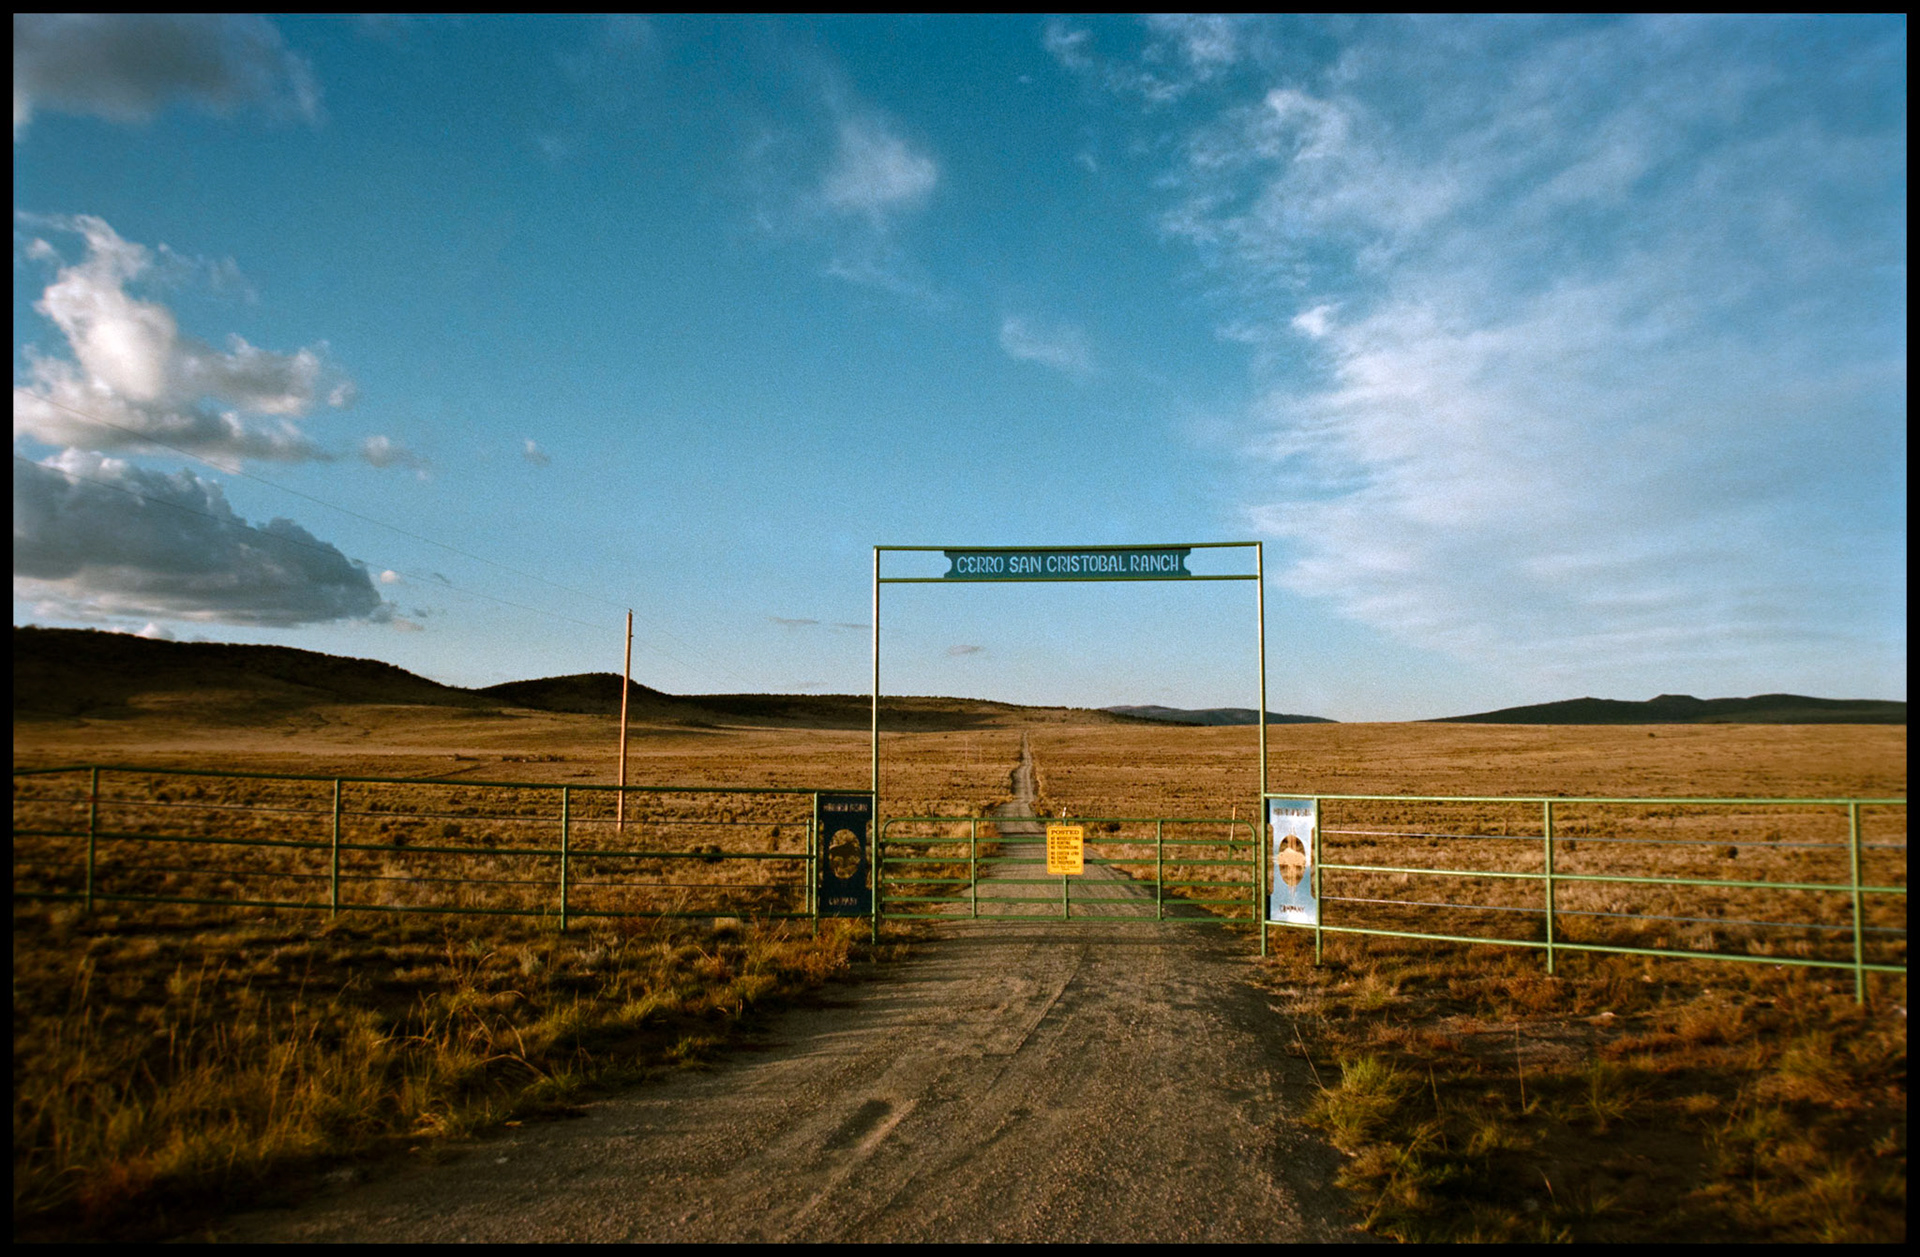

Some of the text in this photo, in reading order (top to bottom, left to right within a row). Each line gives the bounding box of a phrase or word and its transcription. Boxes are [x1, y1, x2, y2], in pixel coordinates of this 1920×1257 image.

[956, 554, 1179, 574] CERRO SAN CRISTOBAL RANCH
[1279, 904, 1305, 912] COMPANY
